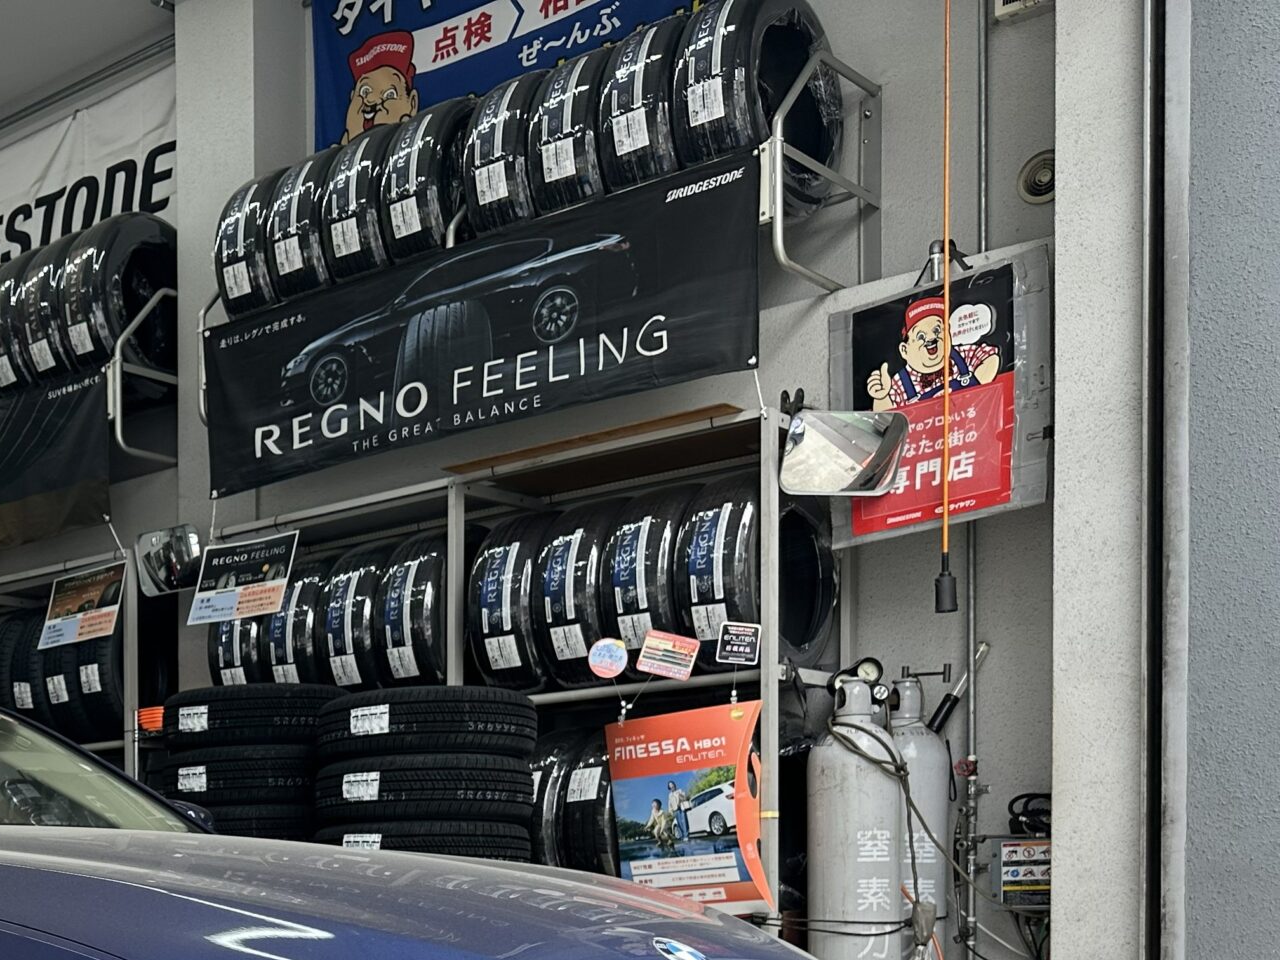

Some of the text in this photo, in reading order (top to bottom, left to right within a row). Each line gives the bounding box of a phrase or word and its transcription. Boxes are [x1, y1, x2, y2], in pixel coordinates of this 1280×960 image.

[431, 11, 494, 63] 点検
[665, 166, 746, 203] BRIDGESTONE
[254, 314, 669, 458] REGNO FEELING
[352, 395, 542, 453] THE GREA BALANCE
[212, 553, 248, 566] REGNO
[251, 545, 286, 560] FEELING
[614, 737, 691, 761] FINESSA
[694, 736, 727, 750] HB01
